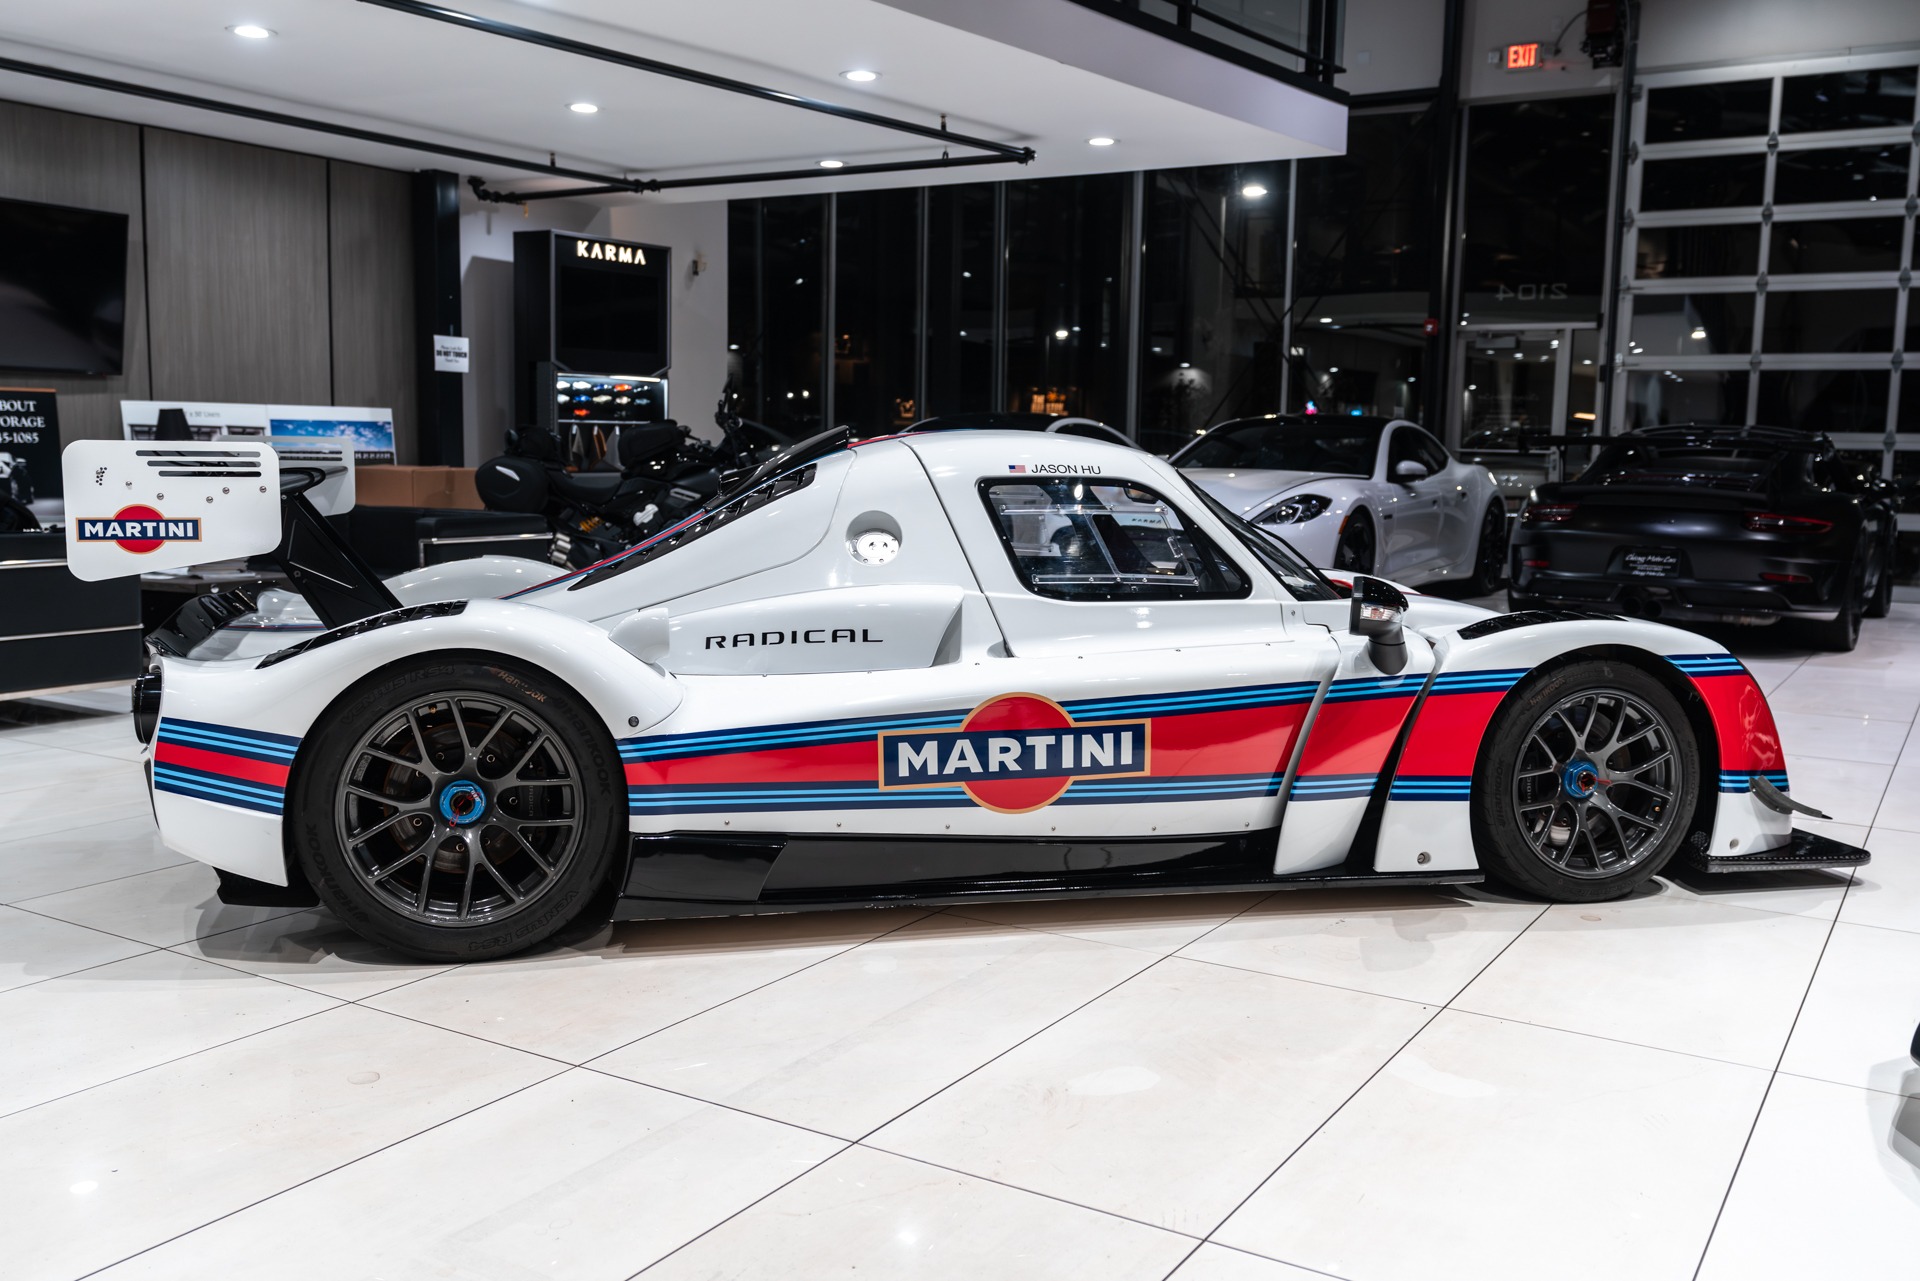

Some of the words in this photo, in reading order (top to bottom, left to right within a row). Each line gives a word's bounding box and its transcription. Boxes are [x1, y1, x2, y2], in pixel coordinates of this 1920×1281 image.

[1508, 43, 1538, 68] EXIT
[577, 240, 646, 265] KARMA
[0, 416, 46, 428] ORAGE
[1031, 464, 1078, 474] JASON
[1081, 465, 1101, 475] HU
[84, 522, 194, 537] MARTINI
[705, 628, 884, 650] RADICAL
[898, 731, 1133, 777] MARTINI
